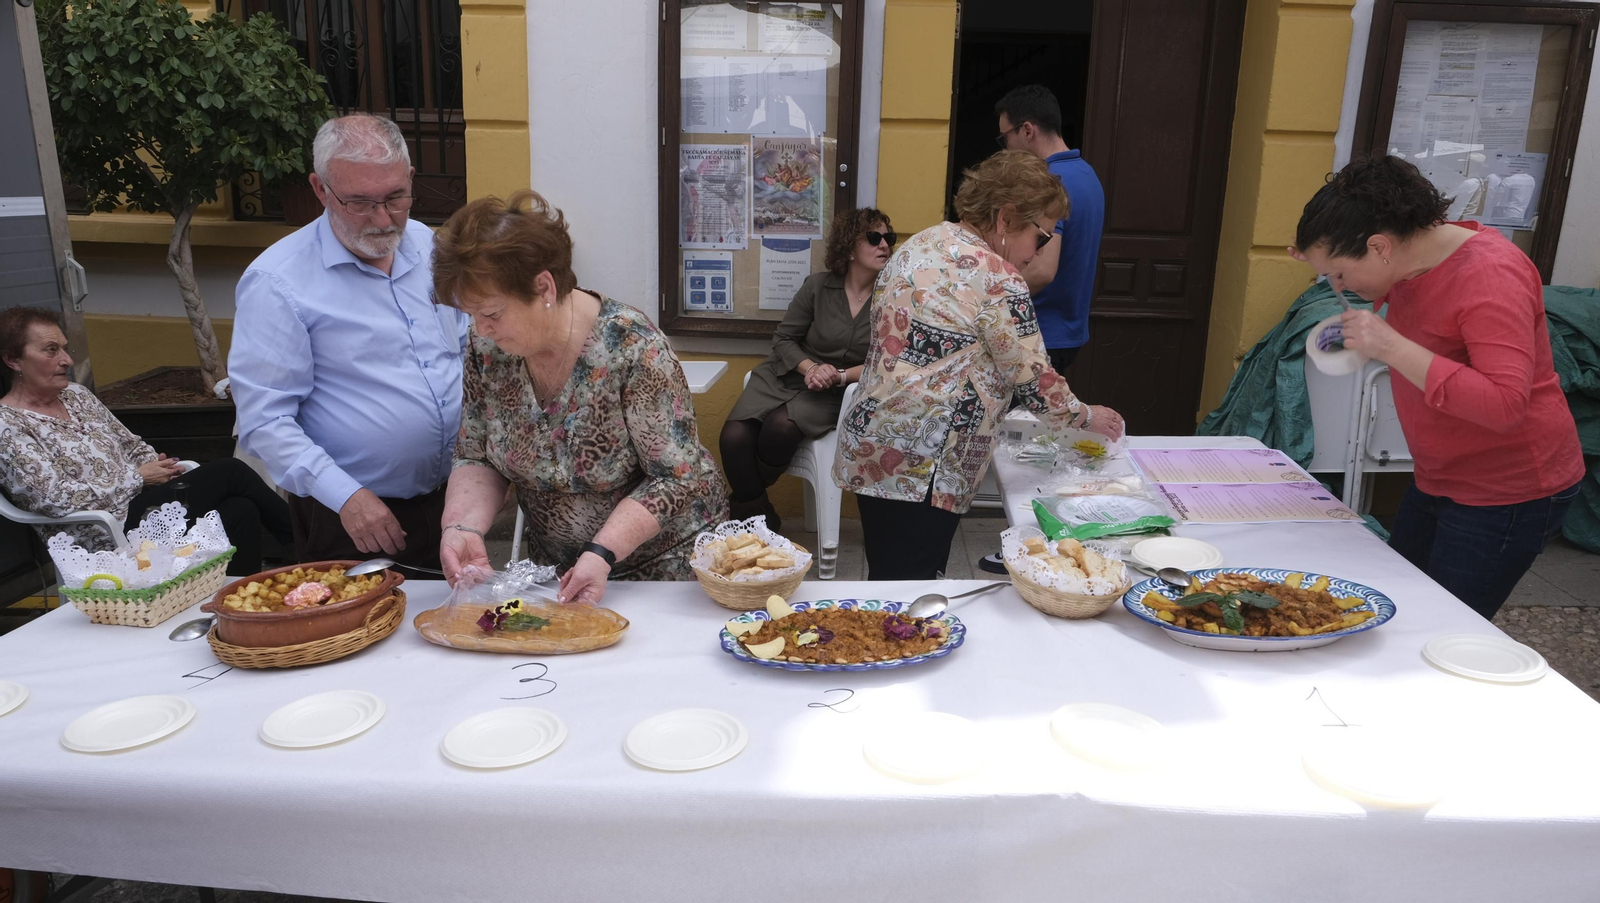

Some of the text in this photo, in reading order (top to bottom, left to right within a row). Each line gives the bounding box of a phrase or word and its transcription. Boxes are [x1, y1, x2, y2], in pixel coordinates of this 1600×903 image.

[500, 662, 557, 699] 3
[808, 688, 861, 713] 2
[1305, 686, 1362, 728] 1
